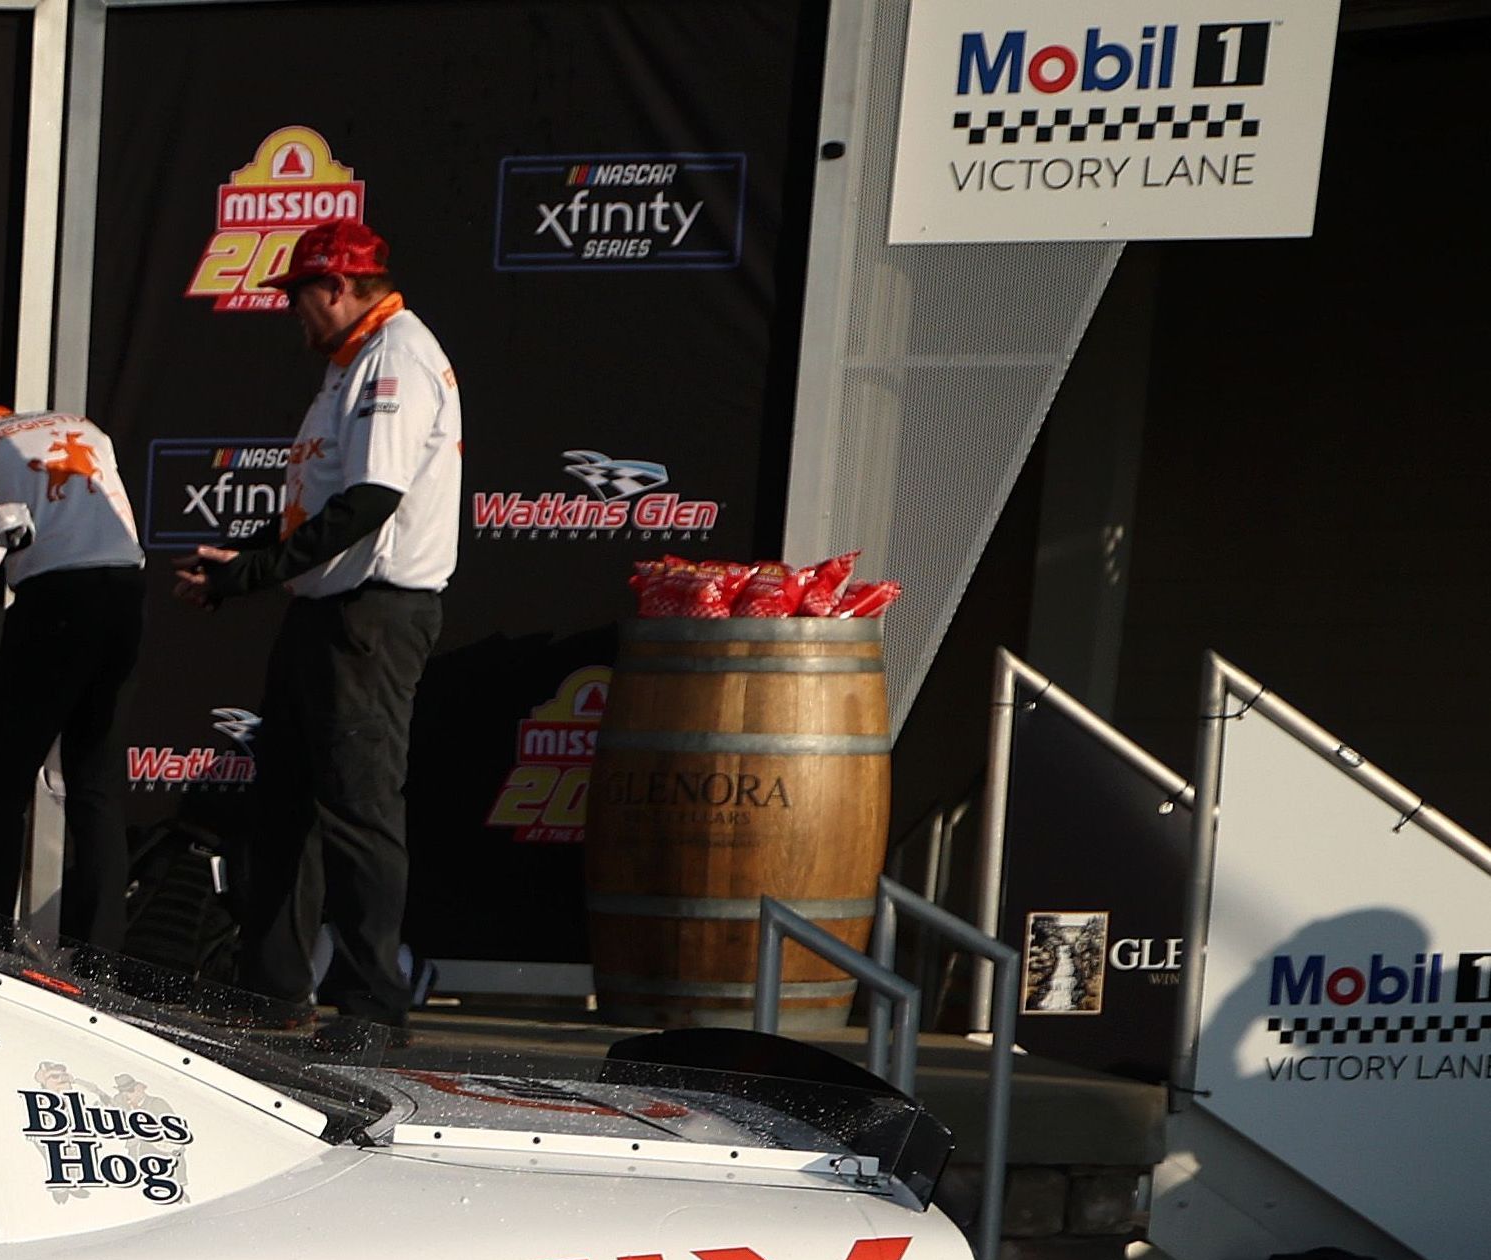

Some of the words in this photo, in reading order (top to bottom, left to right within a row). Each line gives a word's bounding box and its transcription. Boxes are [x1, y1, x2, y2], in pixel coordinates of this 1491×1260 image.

[956, 25, 1178, 95] Mobil
[589, 164, 676, 186] NASCAR
[950, 156, 1134, 192] VICTORY
[1142, 153, 1256, 188] LANE
[223, 189, 358, 223] MISSION
[535, 190, 705, 247] xfinity
[185, 229, 295, 294] 20
[581, 239, 652, 259] SERIES
[238, 448, 290, 469] NASC
[183, 472, 287, 527] xfini
[473, 492, 626, 530] Watkins
[633, 490, 718, 530] Glen
[227, 519, 270, 538] SER
[476, 529, 710, 541] INTERNATIONAL
[524, 728, 598, 756] MISS
[128, 746, 255, 783] Watkin
[488, 767, 591, 825] 20
[1148, 973, 1180, 985] WIN
[1267, 953, 1442, 1007] Mobil
[1266, 1055, 1407, 1082] VICTORY
[18, 1089, 193, 1144] Blues
[43, 1138, 181, 1203] Hog
